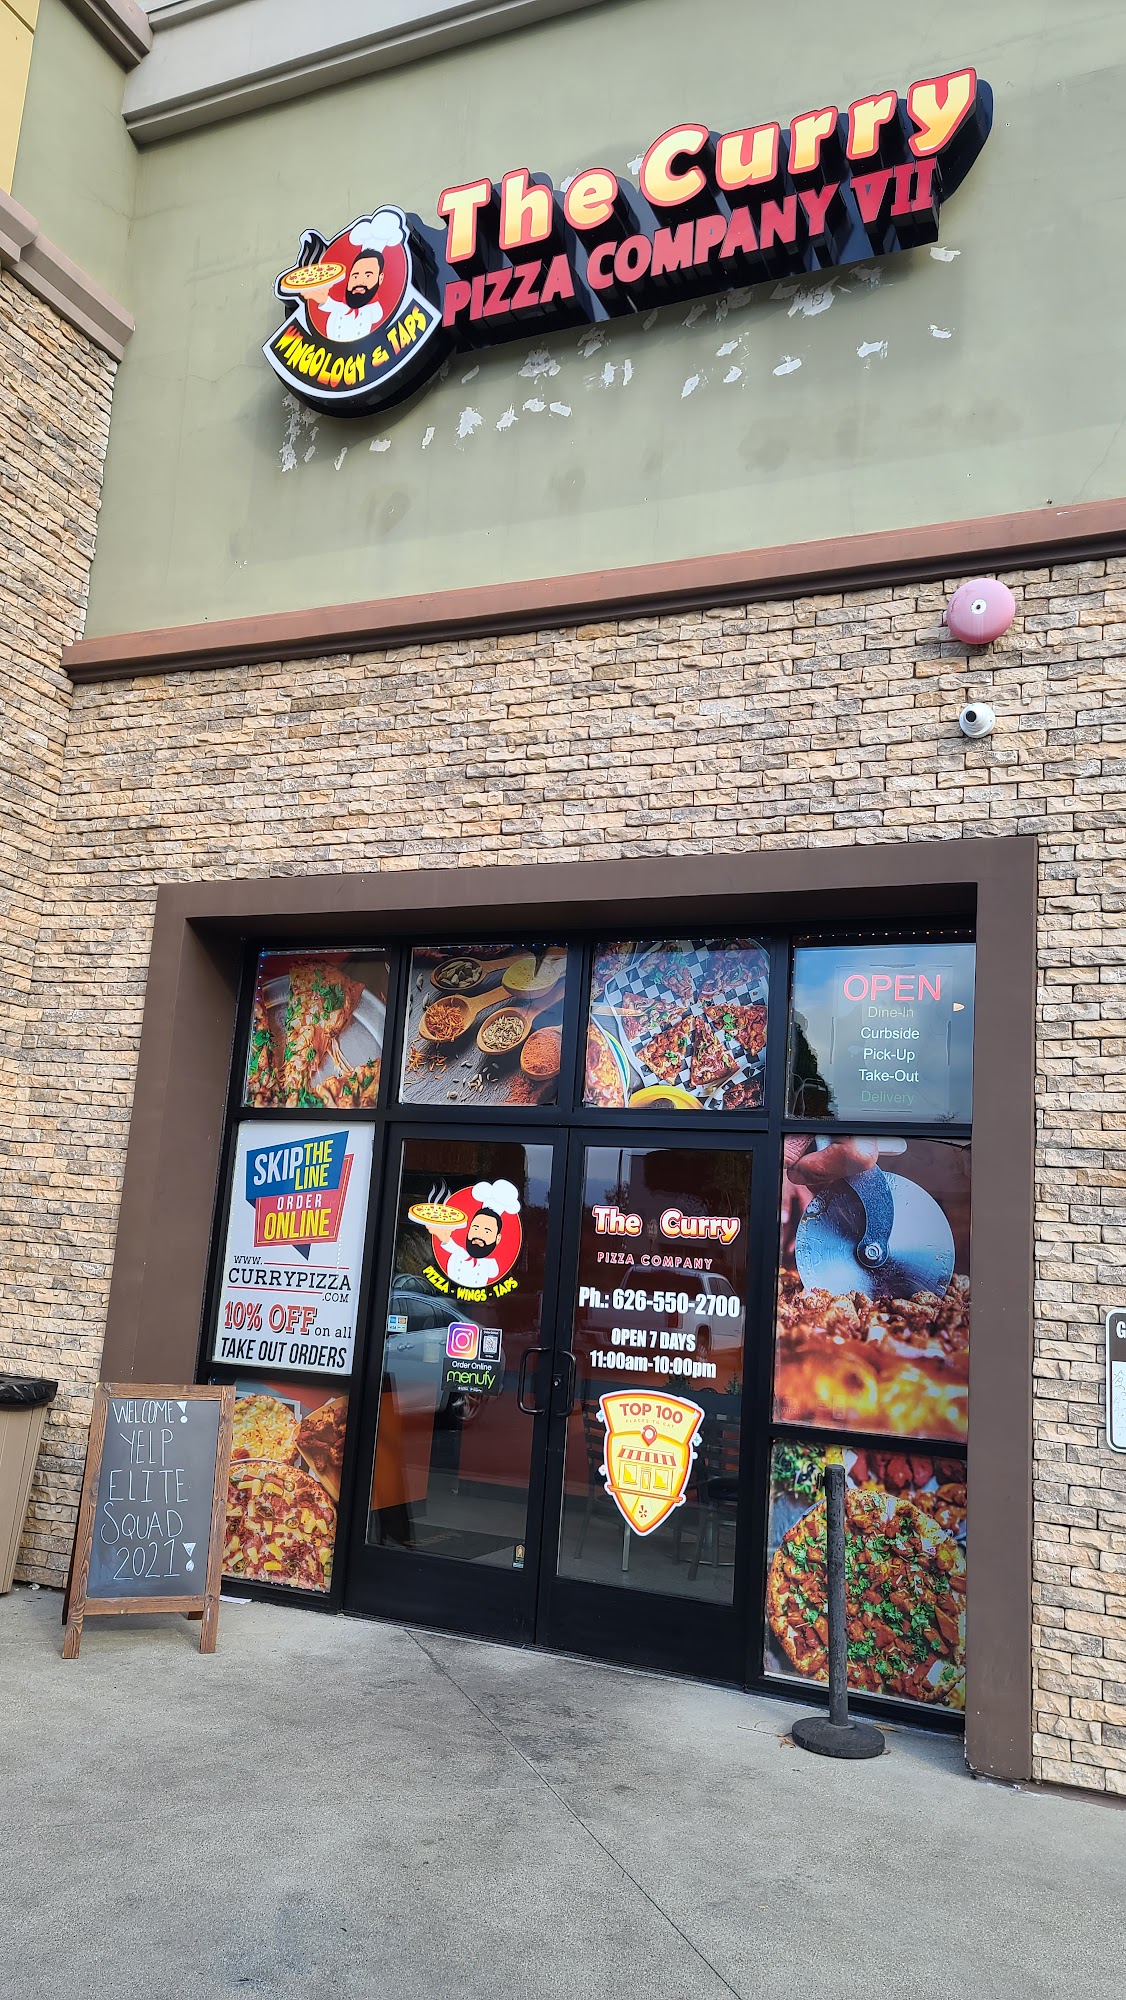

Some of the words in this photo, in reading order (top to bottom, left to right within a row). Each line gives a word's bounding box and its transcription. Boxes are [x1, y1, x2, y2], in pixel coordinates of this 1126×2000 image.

[439, 167, 617, 264] The
[640, 66, 979, 207] Curry
[442, 254, 572, 327] PIZZA
[585, 184, 838, 291] COMPANY
[851, 157, 938, 223] VII
[274, 325, 366, 388] WINGOLOGY
[371, 345, 389, 368] &
[386, 305, 427, 356] TAPS
[843, 974, 941, 1001] OPEN
[868, 1006, 914, 1018] Dine-In
[860, 1027, 920, 1040] Curbside
[863, 1048, 915, 1064] Pick-Up
[858, 1068, 919, 1082] Take-Out
[861, 1090, 915, 1106] Delivery
[253, 1146, 304, 1186] SKIP
[303, 1139, 334, 1164] THE
[294, 1163, 329, 1191] LINE
[276, 1193, 322, 1211] ORDER
[263, 1208, 331, 1241] ONLINE
[592, 1205, 643, 1236] The
[660, 1208, 741, 1245] Curry
[597, 1252, 634, 1265] PIZZA
[640, 1254, 713, 1270] COMPANY
[228, 1267, 351, 1291] CURRYPIZZA
[422, 1265, 449, 1294] PIZZA
[456, 1286, 487, 1302] WINGS
[493, 1276, 519, 1298] TAPS
[321, 1291, 349, 1303] .COM
[579, 1286, 609, 1309] Ph.:
[612, 1288, 741, 1318] 626-550-2700
[224, 1300, 263, 1332] 10%
[268, 1303, 318, 1337] OFF
[314, 1327, 331, 1338] on
[334, 1326, 352, 1339] all
[221, 1337, 256, 1360] TAKE
[258, 1340, 287, 1364] OUT
[288, 1343, 347, 1368] ORDERS
[611, 1328, 646, 1348] OPEN
[649, 1332, 657, 1348] 7
[659, 1333, 696, 1352] DAYS
[452, 1360, 470, 1369] Order
[471, 1362, 492, 1371] Online
[590, 1350, 717, 1379] 11:00am-10:00pm
[446, 1370, 496, 1389] menufy
[112, 1400, 188, 1425] WELCOME!
[619, 1402, 652, 1416] TOP
[655, 1405, 683, 1424] 100
[119, 1428, 174, 1467] YELP
[109, 1468, 189, 1503] ELITE
[100, 1501, 184, 1545] SQUAD
